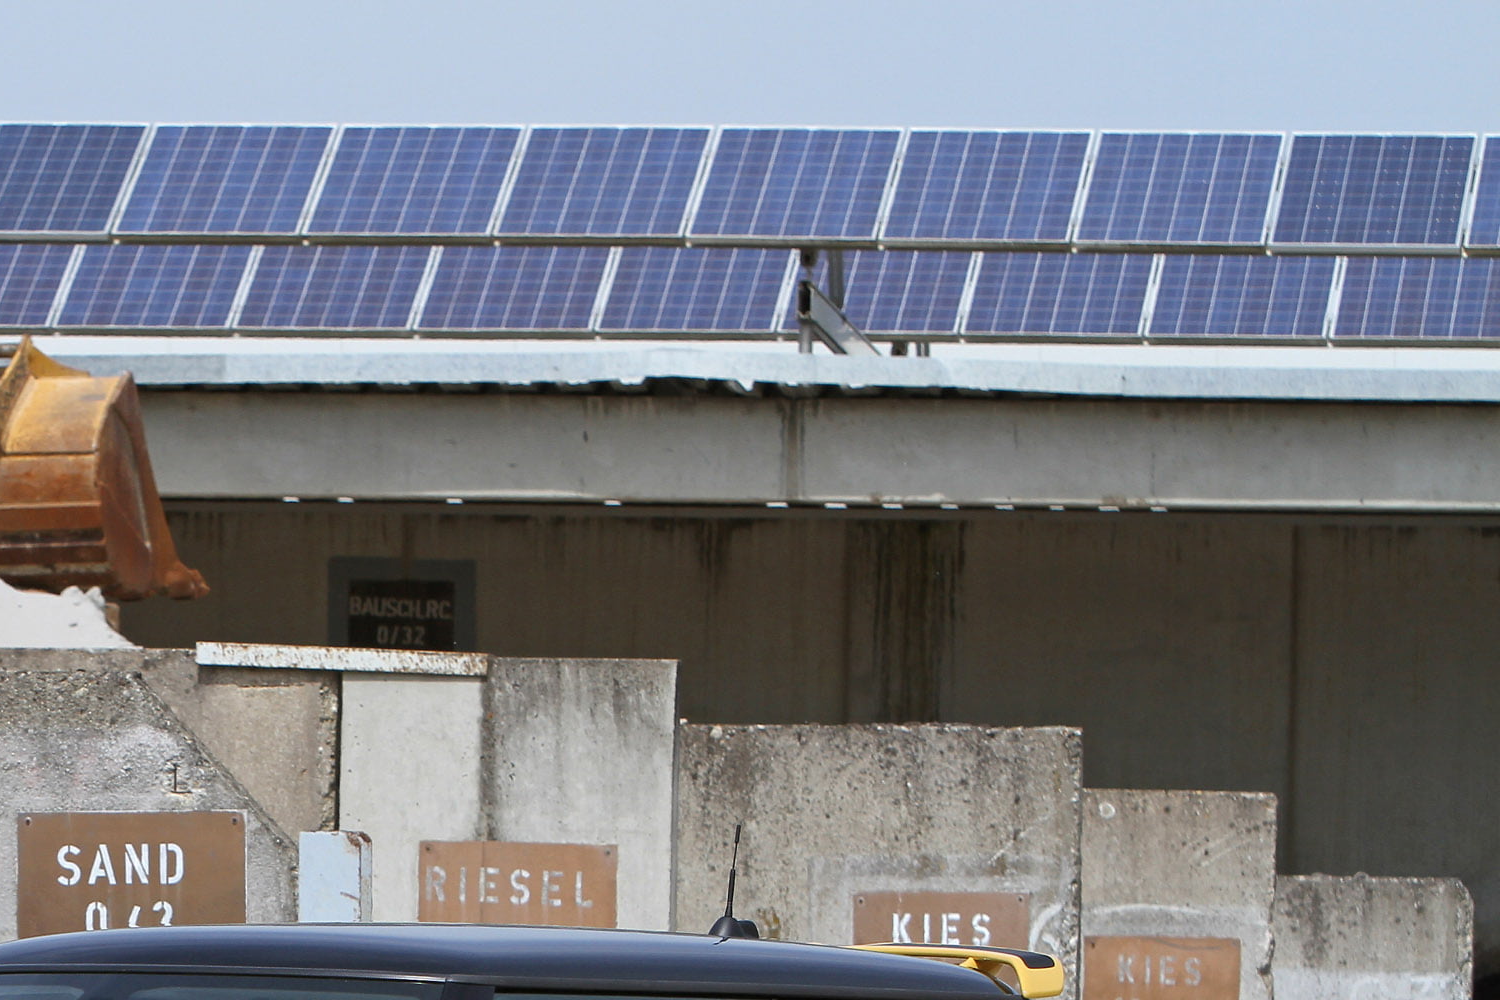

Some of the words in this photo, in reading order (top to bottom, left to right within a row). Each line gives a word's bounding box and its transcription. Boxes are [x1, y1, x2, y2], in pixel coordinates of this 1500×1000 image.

[376, 624, 426, 646] 0/32
[56, 843, 185, 886] SAND
[424, 865, 594, 908] RIESEL
[892, 913, 992, 947] KIES
[1117, 954, 1202, 986] KIES
